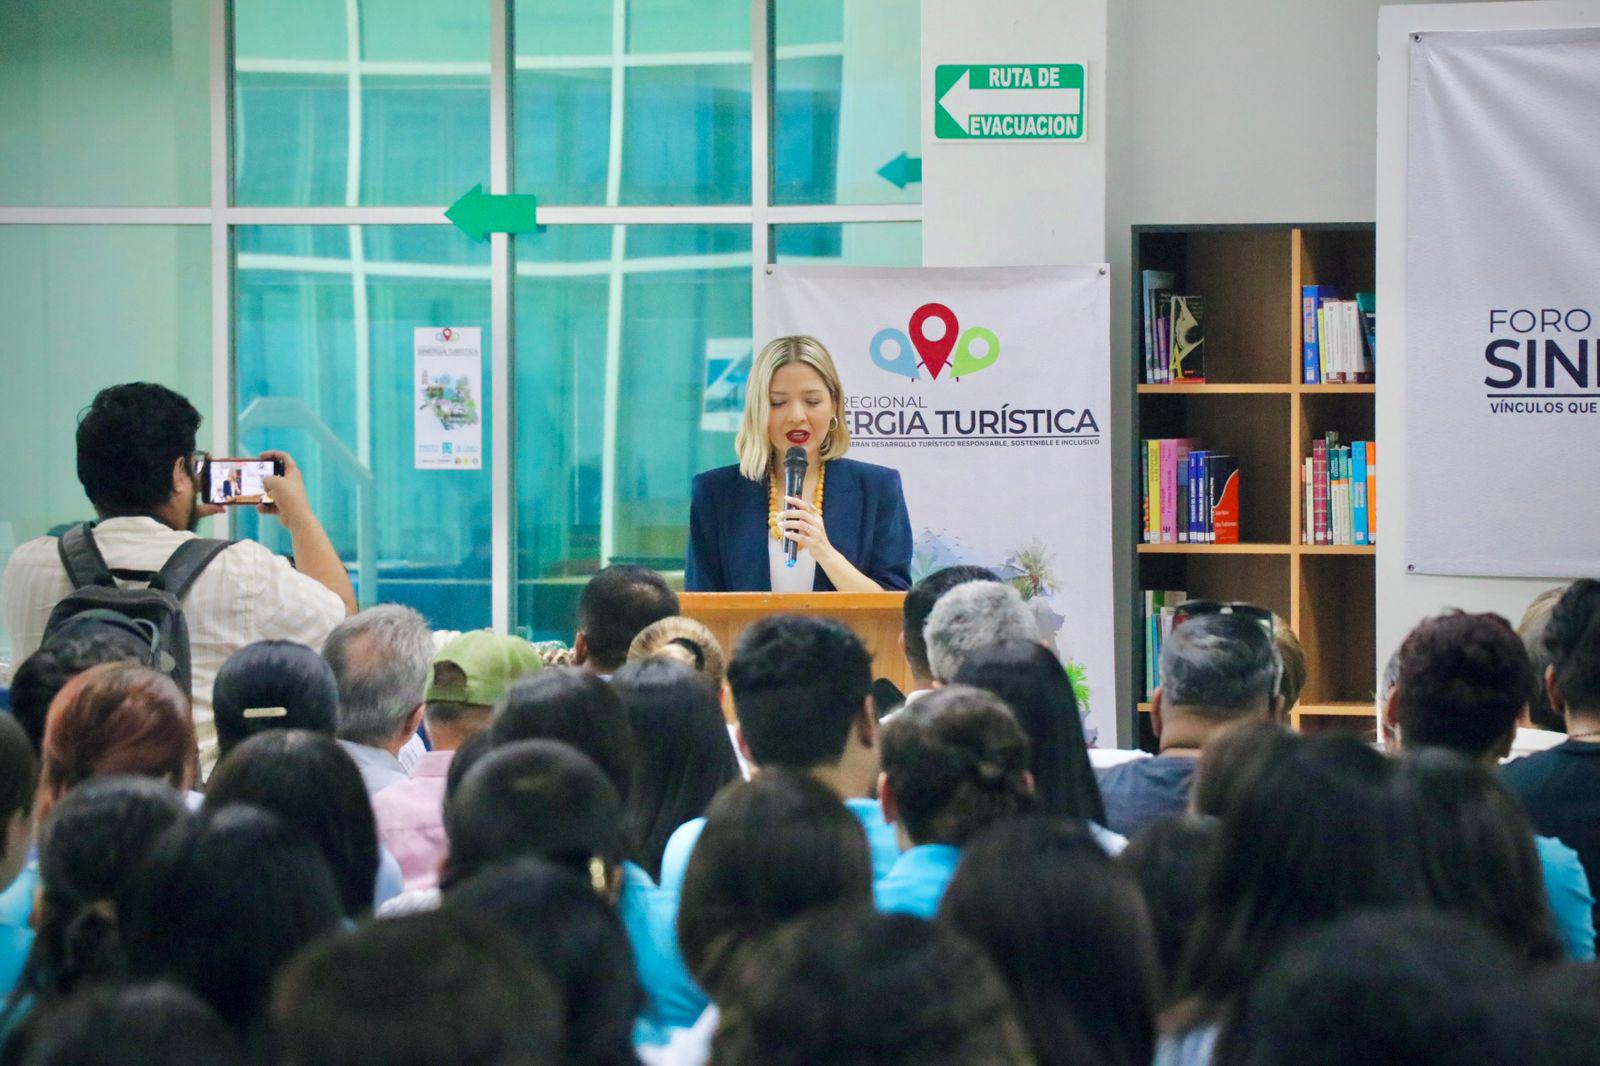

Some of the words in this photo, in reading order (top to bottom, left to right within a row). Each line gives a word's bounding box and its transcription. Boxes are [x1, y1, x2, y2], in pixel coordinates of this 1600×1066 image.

[989, 67, 1033, 87] RUTA
[1038, 67, 1060, 87] DE
[970, 116, 1078, 136] EVACUACION
[1489, 308, 1592, 333] FORO
[1484, 338, 1600, 389] SIN
[1490, 399, 1564, 414] VÍNCULOS
[1567, 401, 1598, 414] QUE
[934, 403, 1100, 436] TURÍSTICA
[871, 440, 917, 448] DESARROLLO
[918, 439, 956, 448] TURÍSTICO
[1011, 439, 1054, 447] SOSTENIBLE
[1061, 438, 1101, 446] INCLUSIVO
